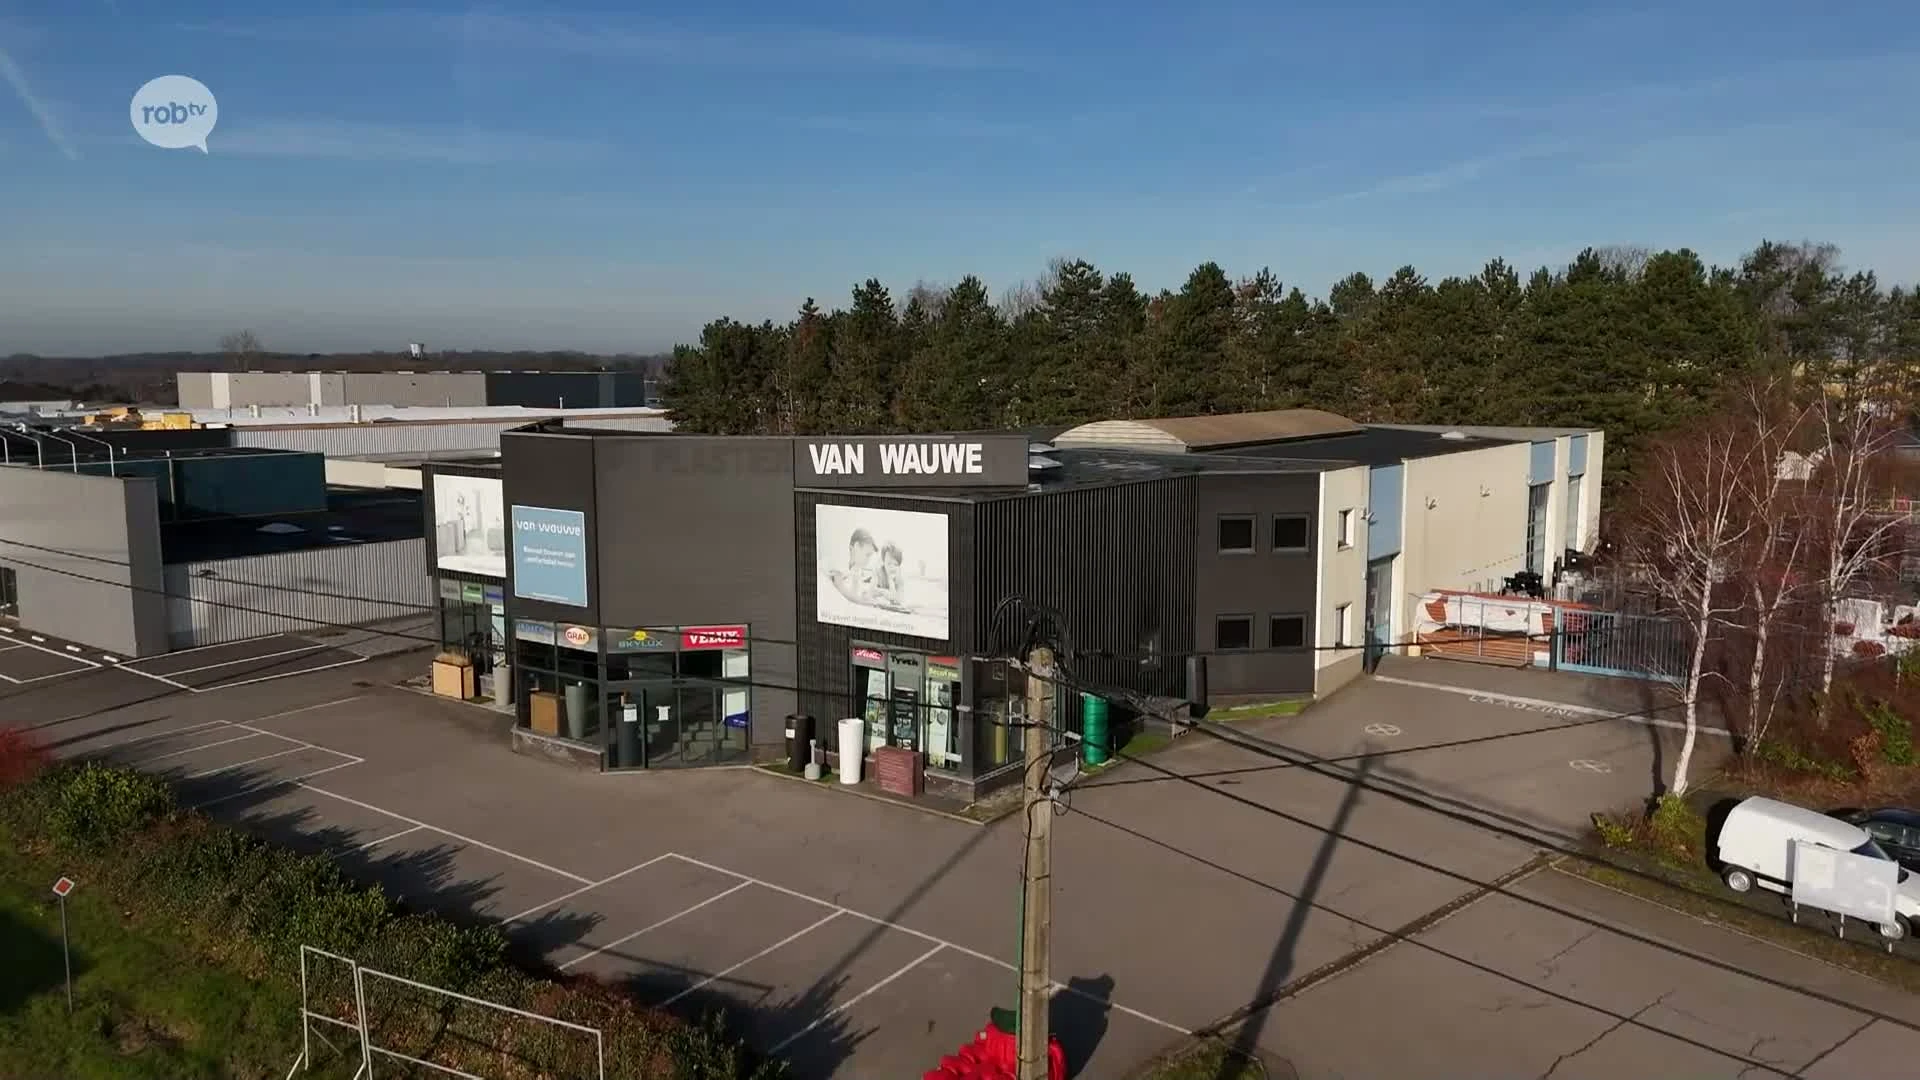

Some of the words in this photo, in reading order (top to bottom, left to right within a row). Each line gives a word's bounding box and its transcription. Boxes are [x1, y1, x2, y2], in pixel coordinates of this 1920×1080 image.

[808, 443, 864, 475] VAN
[879, 443, 983, 474] WAUWE
[516, 520, 536, 531] van
[538, 523, 581, 536] wauwe
[618, 639, 664, 649] SKYLUX
[689, 630, 738, 645] VELUX
